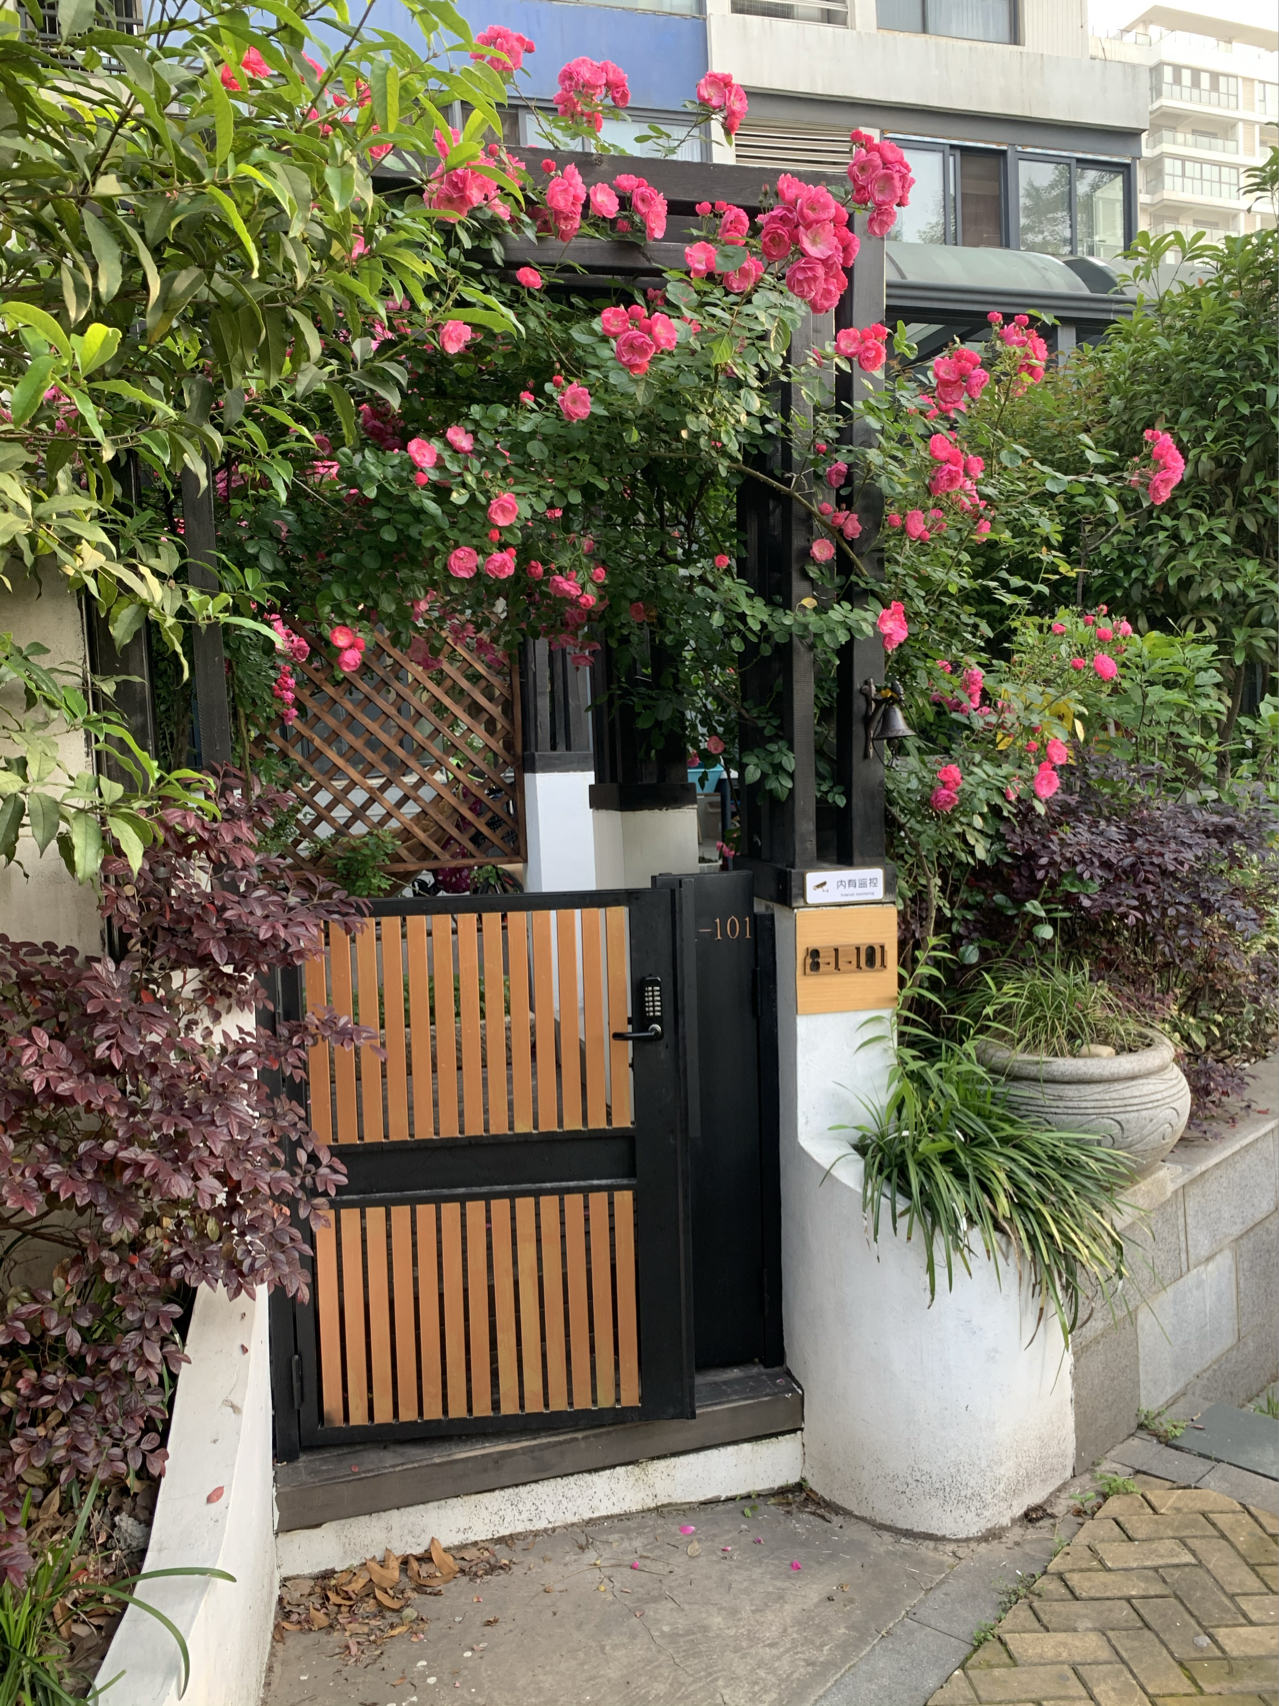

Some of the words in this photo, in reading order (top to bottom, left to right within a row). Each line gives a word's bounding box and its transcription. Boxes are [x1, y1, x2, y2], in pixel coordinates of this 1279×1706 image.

[836, 877, 878, 889] 内有监控
[695, 915, 752, 941] -101
[805, 944, 886, 974] 8-1-101
